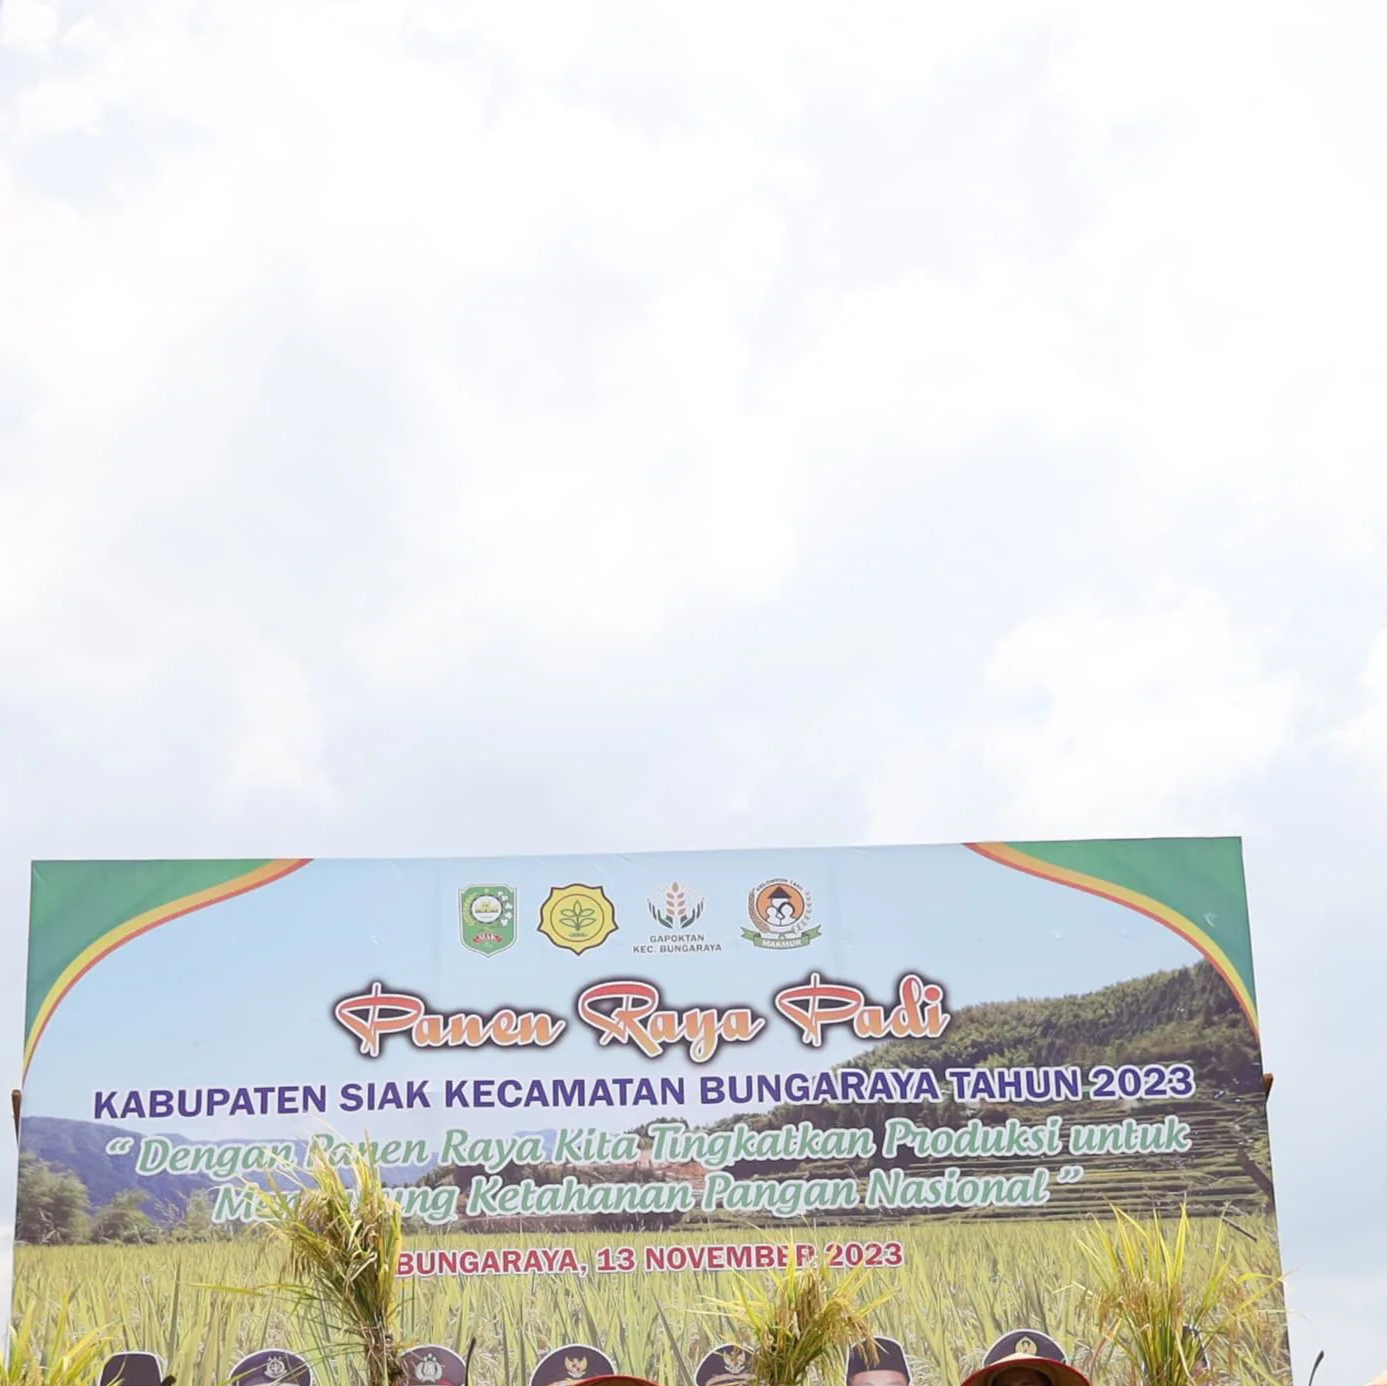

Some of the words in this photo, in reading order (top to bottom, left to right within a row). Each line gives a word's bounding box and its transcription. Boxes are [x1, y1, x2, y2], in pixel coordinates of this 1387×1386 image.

[650, 933, 705, 943] GAPOKTAN
[660, 944, 722, 952] BUNGARAYA
[335, 982, 565, 1056] Panen
[579, 981, 765, 1062] Raya
[775, 973, 950, 1046] Padi
[94, 1085, 326, 1119] KABUPATEN
[340, 1081, 430, 1111] SIAK
[445, 1077, 684, 1107] KECAMATAN
[700, 1071, 939, 1104] BUNGARAYA
[949, 1070, 1079, 1099] TAHUN
[1092, 1067, 1193, 1097] 2023
[139, 1139, 297, 1177] Dengan
[307, 1133, 430, 1167] Panen
[441, 1129, 543, 1171] Raya
[554, 1128, 638, 1162] Kita
[651, 1122, 874, 1168] Tingkatkan
[885, 1117, 1061, 1157] Produksi
[1071, 1116, 1190, 1151] untuk
[469, 1177, 691, 1213] Ketahanan
[705, 1173, 858, 1215] Pangan
[867, 1167, 1049, 1206] Nasional
[396, 1249, 587, 1276] BUNGARAYA,
[597, 1247, 635, 1270] 13
[645, 1245, 815, 1269] NOVEMBER
[825, 1242, 903, 1266] 2023
